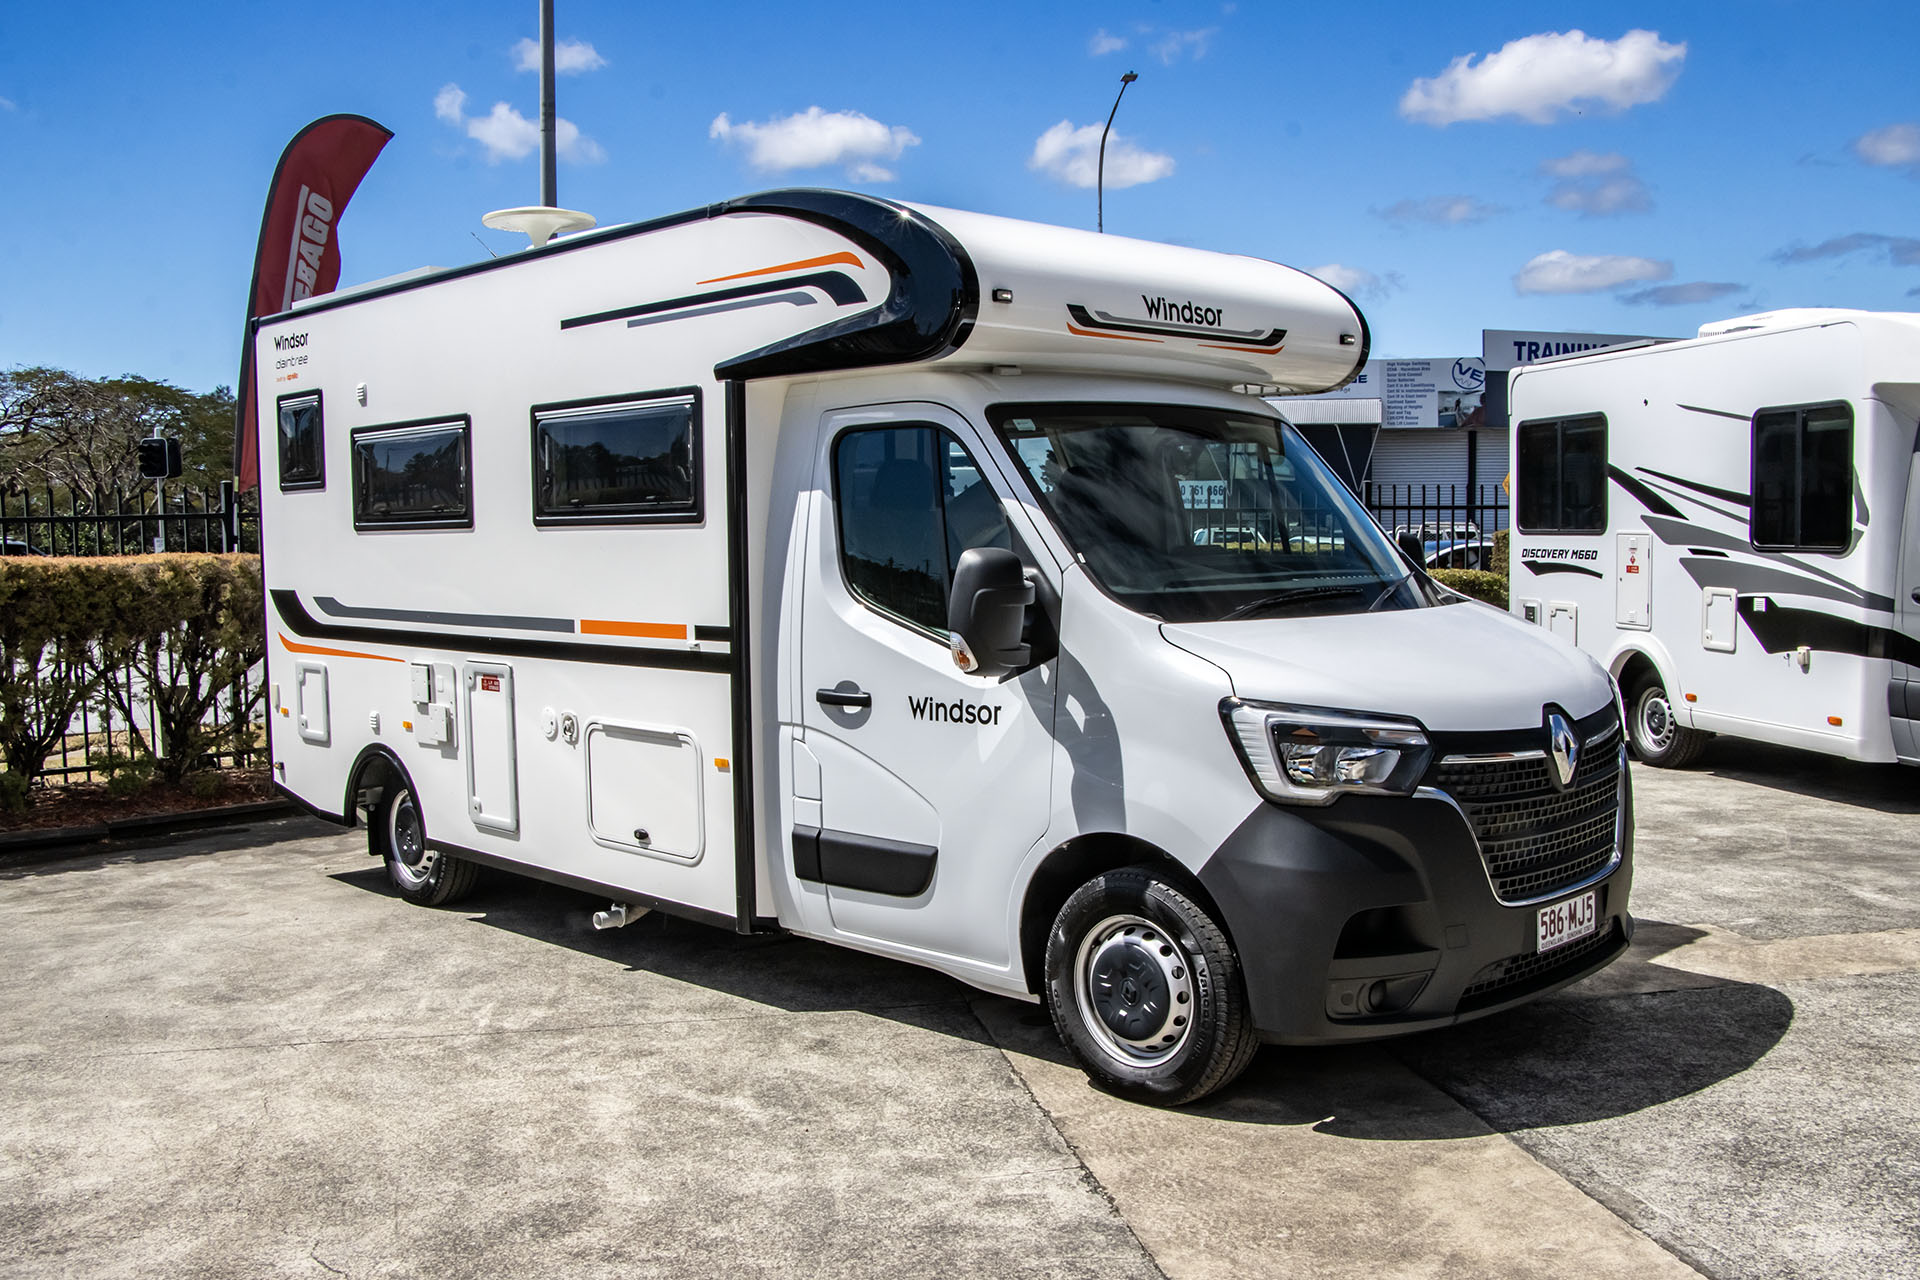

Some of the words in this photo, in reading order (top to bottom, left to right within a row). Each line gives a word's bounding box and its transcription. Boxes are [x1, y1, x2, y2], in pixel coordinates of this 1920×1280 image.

[1141, 294, 1223, 328] Windsor
[274, 332, 308, 352] Windsor
[1513, 341, 1610, 362] TRAIN
[275, 354, 308, 370] daintree
[1521, 548, 1570, 559] DISCOVERY
[1570, 549, 1598, 560] M660
[907, 695, 1002, 725] Windsor
